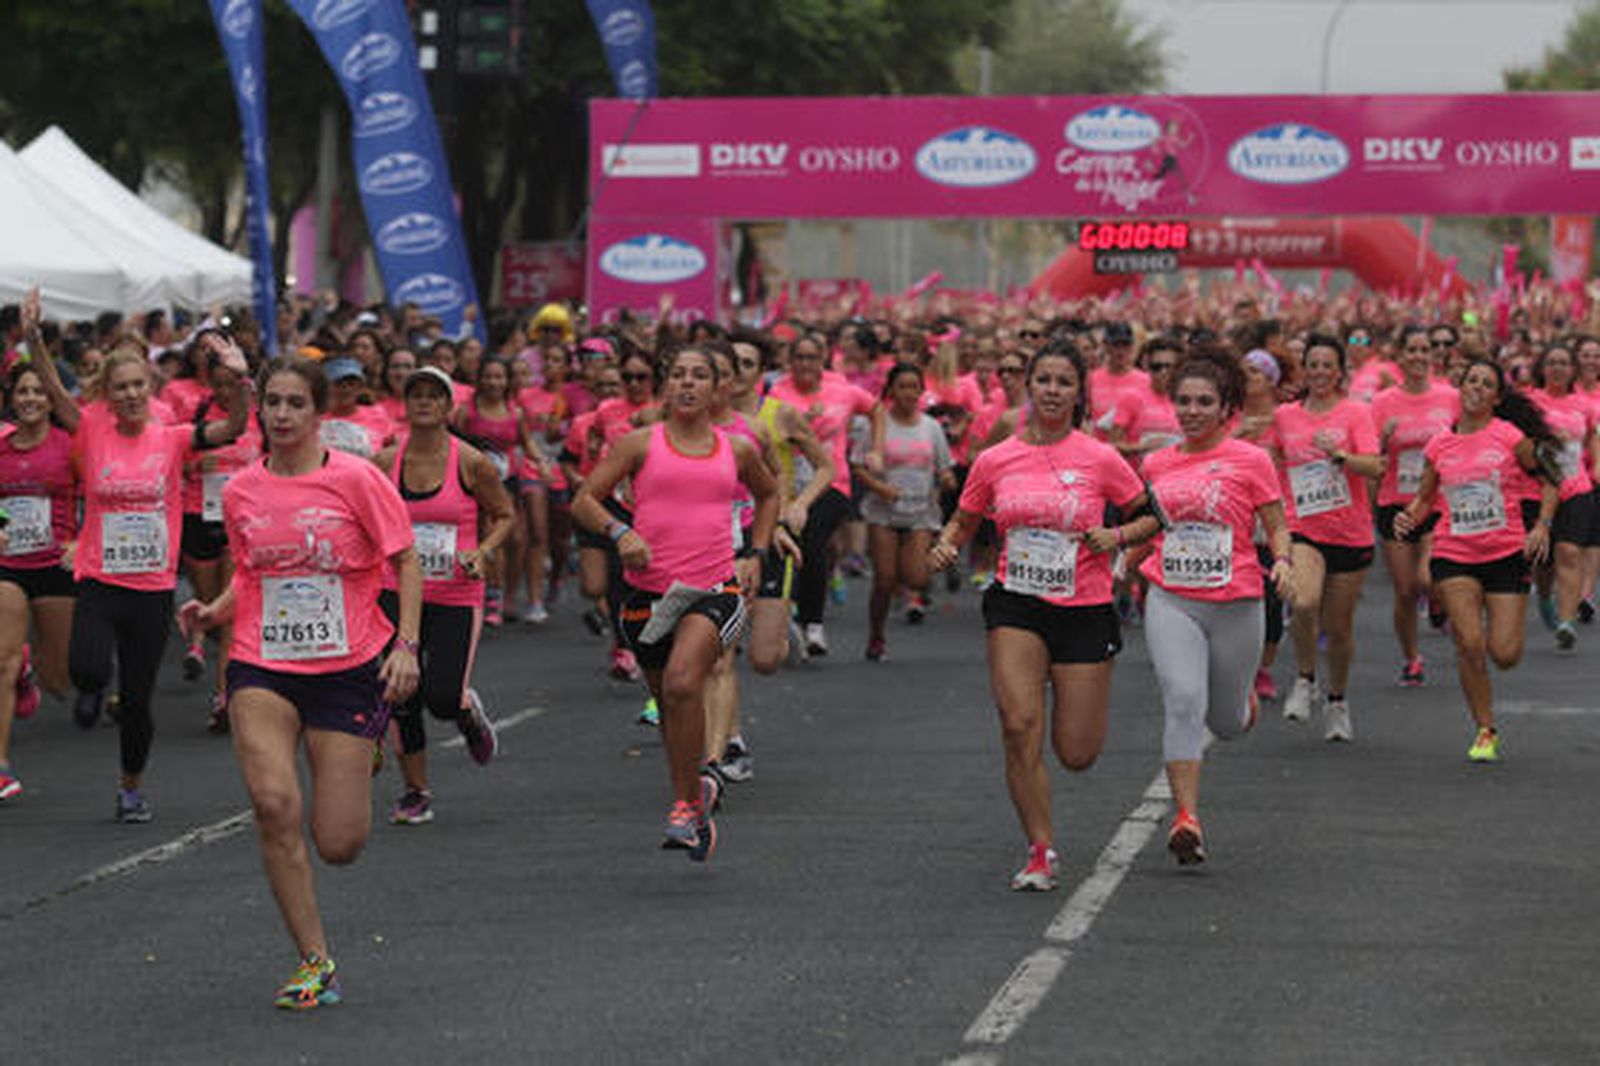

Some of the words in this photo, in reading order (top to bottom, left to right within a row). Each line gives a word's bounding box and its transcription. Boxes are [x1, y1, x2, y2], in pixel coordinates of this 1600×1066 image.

[711, 143, 789, 167] DKV
[800, 147, 899, 171] OYSHO
[1238, 146, 1341, 168] ASTURIANA
[1364, 137, 1444, 161] DKV
[1456, 140, 1559, 166] OYSHO
[1097, 254, 1177, 272] OYSHO
[279, 620, 330, 643] 7613
